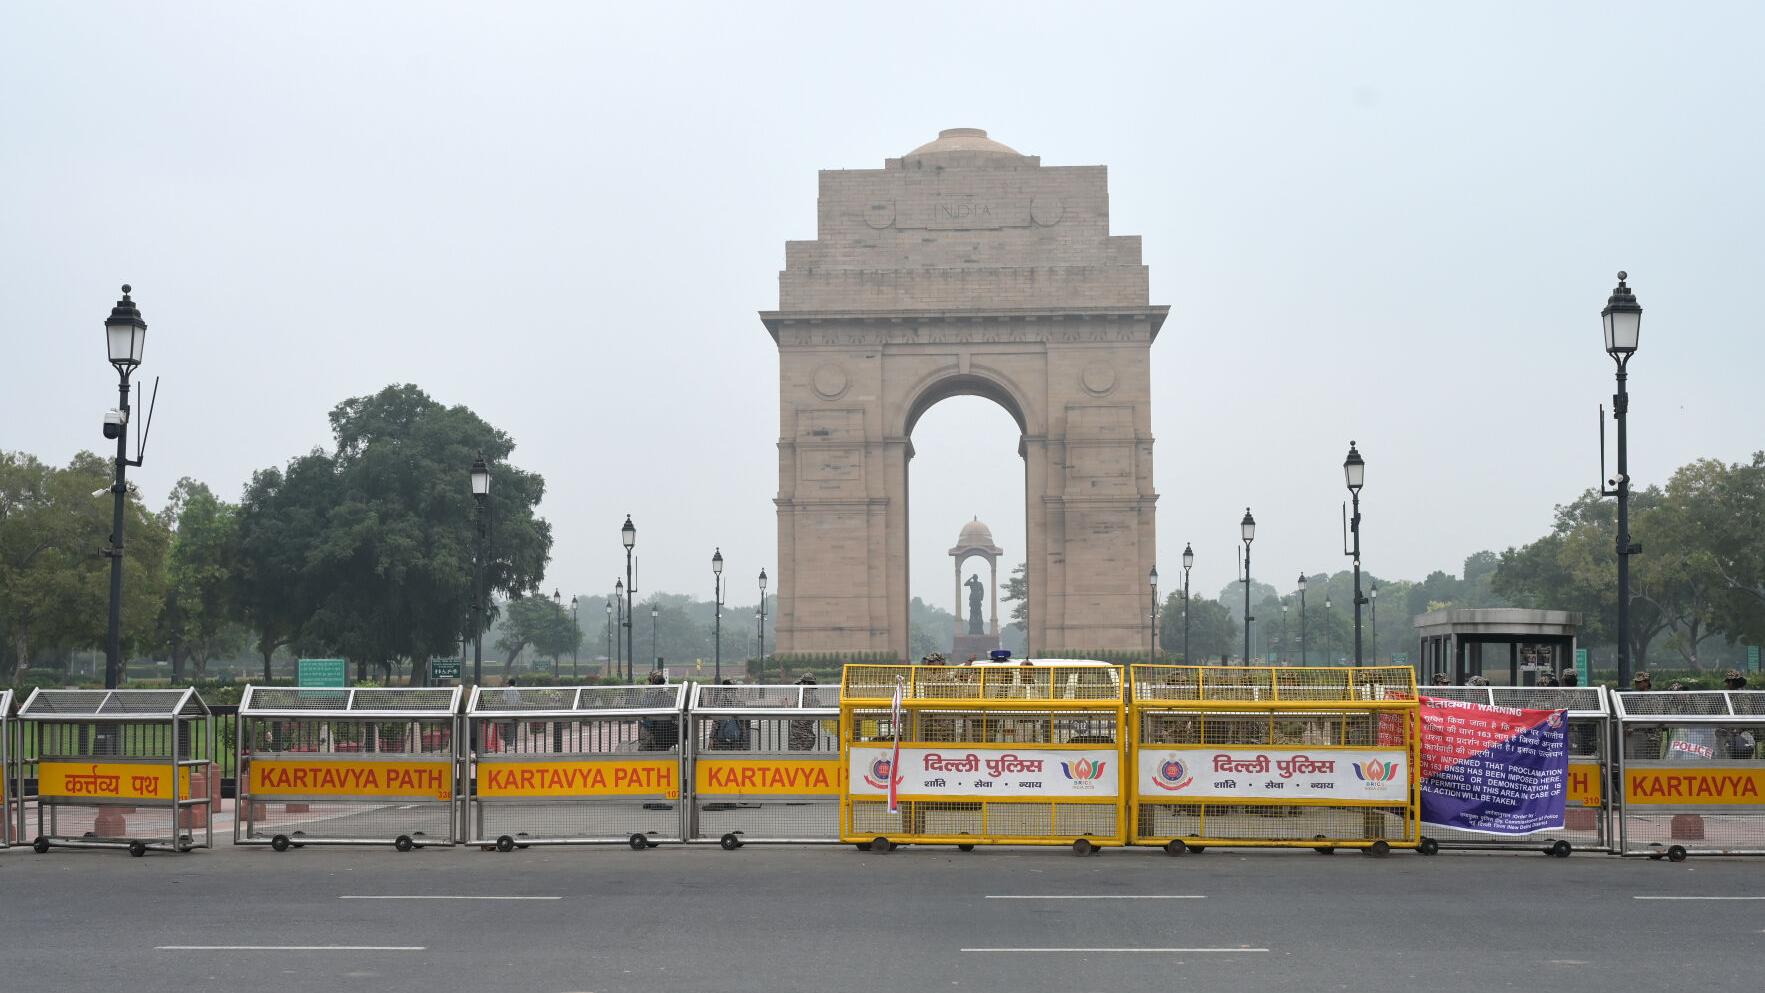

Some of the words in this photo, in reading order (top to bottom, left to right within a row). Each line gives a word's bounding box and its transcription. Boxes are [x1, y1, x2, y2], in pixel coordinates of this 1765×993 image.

[934, 204, 991, 217] INDIA
[1478, 703, 1522, 716] WARNING
[1672, 740, 1713, 758] POLICE
[923, 753, 980, 772] दिल्ली
[985, 753, 1044, 778] पुलिस
[1212, 754, 1270, 773] दिल्ली
[1276, 754, 1335, 778] पुलिस
[1441, 756, 1481, 767] INFORMED
[1485, 761, 1504, 770] THAT
[1509, 765, 1563, 777] PROCLAMATION
[1444, 765, 1465, 774] BNSS
[1467, 767, 1483, 776] HAS
[1485, 770, 1505, 779] BEEN
[1508, 773, 1538, 785] IMPOSED
[131, 775, 160, 796] पथ
[260, 767, 379, 788] KARTAVYA
[386, 769, 443, 789] PATH
[487, 767, 606, 789] KARTAVYA
[614, 767, 671, 788] PATH
[708, 767, 829, 788] KARTAVYA
[974, 778, 993, 788] सेवा
[1018, 781, 1042, 789] न्याय
[1264, 779, 1284, 789] सेवा
[1310, 782, 1334, 790] न्याय
[1424, 769, 1465, 781] GATHERING
[1470, 776, 1482, 784] OR
[1487, 779, 1549, 792] DEMONSTRATION
[1632, 775, 1759, 797] KARTAVYA
[1431, 779, 1472, 791] PERMITTED
[1482, 786, 1499, 795] THIS
[1500, 789, 1522, 798] AREA
[1530, 791, 1549, 800] CASE
[1434, 788, 1461, 798] ACTION
[1461, 792, 1480, 801] WILL
[1583, 796, 1600, 805] 310
